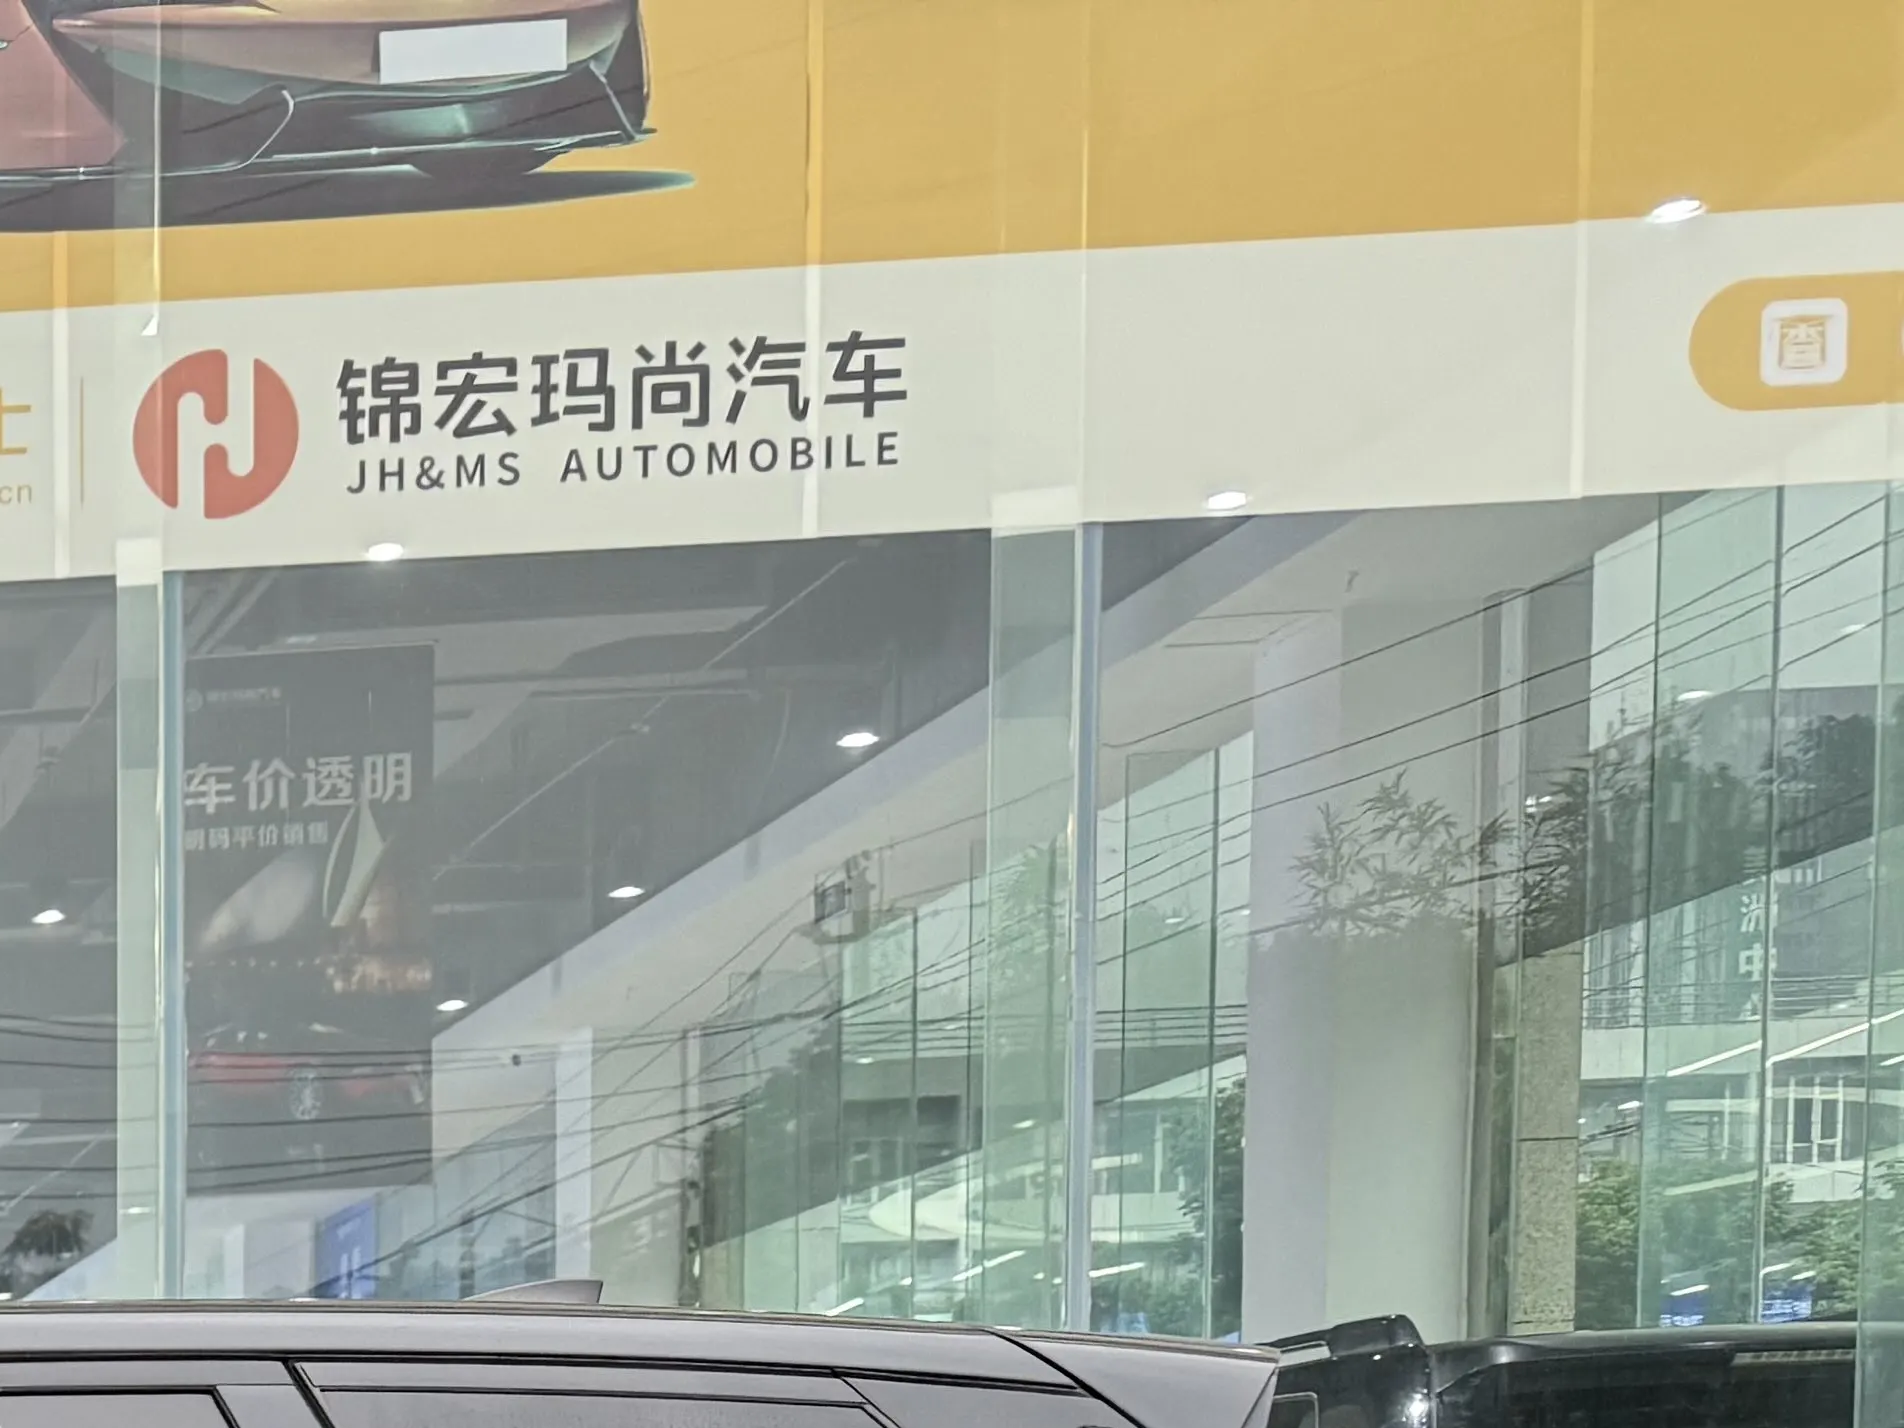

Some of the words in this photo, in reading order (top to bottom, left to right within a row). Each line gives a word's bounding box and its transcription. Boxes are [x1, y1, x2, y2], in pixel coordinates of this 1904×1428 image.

[336, 330, 908, 445] 锦宏玛尚汽车
[345, 451, 523, 495] JH&MS
[559, 431, 900, 484] AUTOMOBILE
[185, 752, 413, 815] 车价透明
